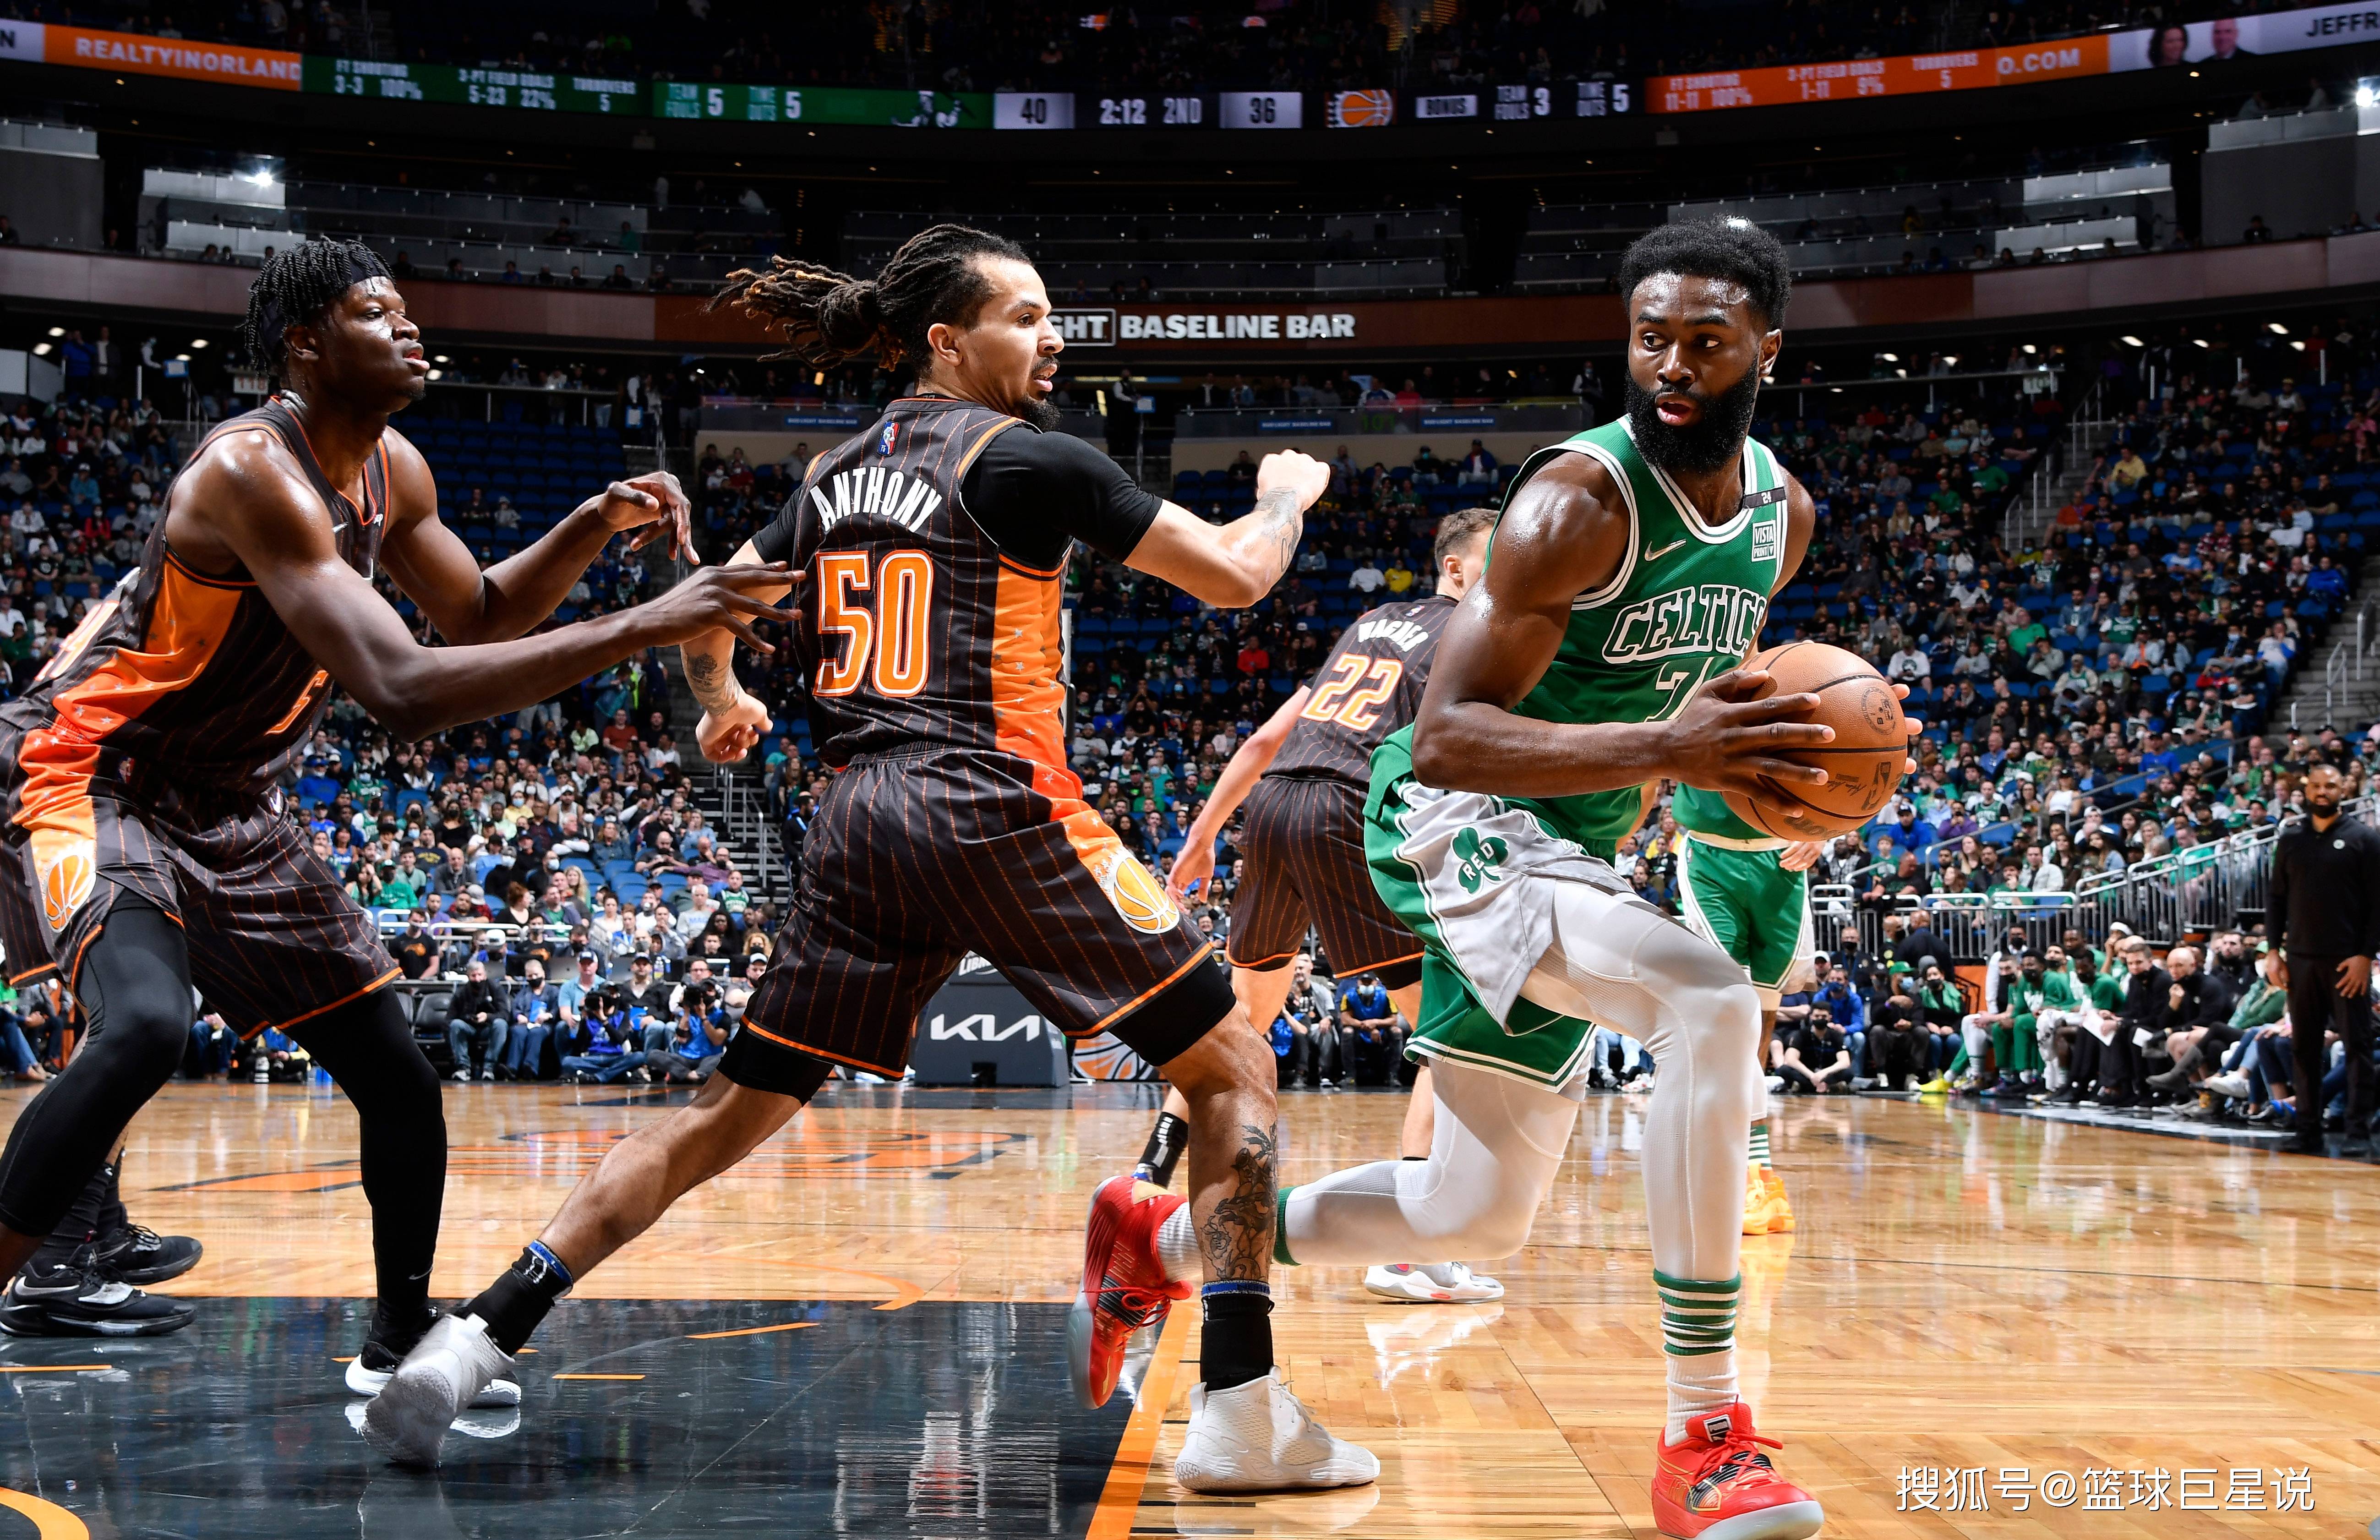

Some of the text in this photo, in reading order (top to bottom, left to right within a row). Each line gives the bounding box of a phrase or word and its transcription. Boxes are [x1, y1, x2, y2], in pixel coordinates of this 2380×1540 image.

[1996, 49, 2080, 74] O.COM
[599, 93, 611, 112] 5
[707, 87, 724, 116] 5
[785, 91, 801, 119] 5
[1021, 98, 1046, 124] 40
[1163, 98, 1201, 123] 2ND
[1250, 97, 1275, 123] 36
[1534, 87, 1550, 115] 3
[1612, 83, 1629, 112] 5
[1100, 99, 1145, 124] 2:12
[1120, 315, 1279, 339] BASELINE
[1286, 315, 1355, 338] BAR
[810, 466, 942, 532] ANTHONY
[1761, 491, 1772, 504] 24
[1754, 525, 1774, 544] VISTA
[1753, 547, 1769, 557] PRINT
[812, 549, 934, 698] 50
[1299, 653, 1403, 731] 22
[1643, 657, 1714, 723] 7
[1463, 842, 1494, 881] RED
[930, 1014, 1040, 1042] KIA
